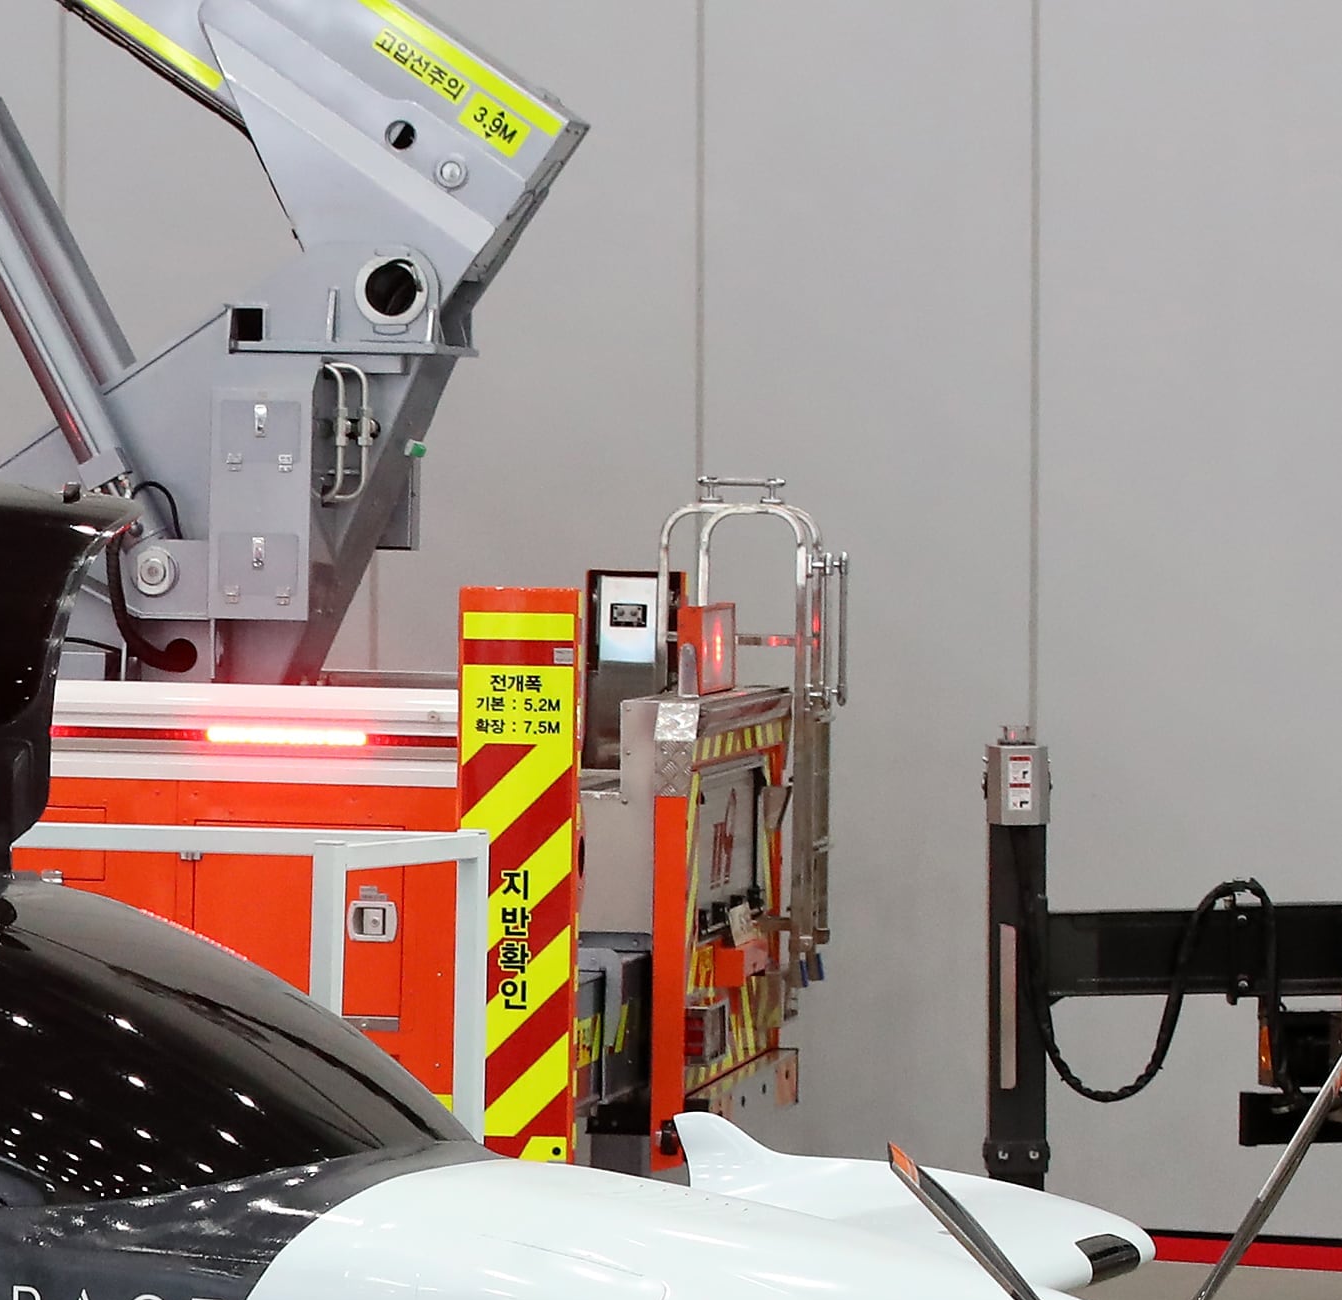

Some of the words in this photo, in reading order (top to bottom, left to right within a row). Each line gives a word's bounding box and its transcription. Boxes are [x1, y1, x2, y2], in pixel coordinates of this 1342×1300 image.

[374, 31, 465, 101] 고압선주의
[473, 107, 518, 144] 3.9M
[490, 674, 542, 692] 전개폭
[476, 697, 505, 711] 기본
[524, 698, 561, 712] 5.2M
[475, 718, 505, 733] 확장
[524, 720, 561, 734] 7.5M
[500, 870, 530, 1010] 지반확인
